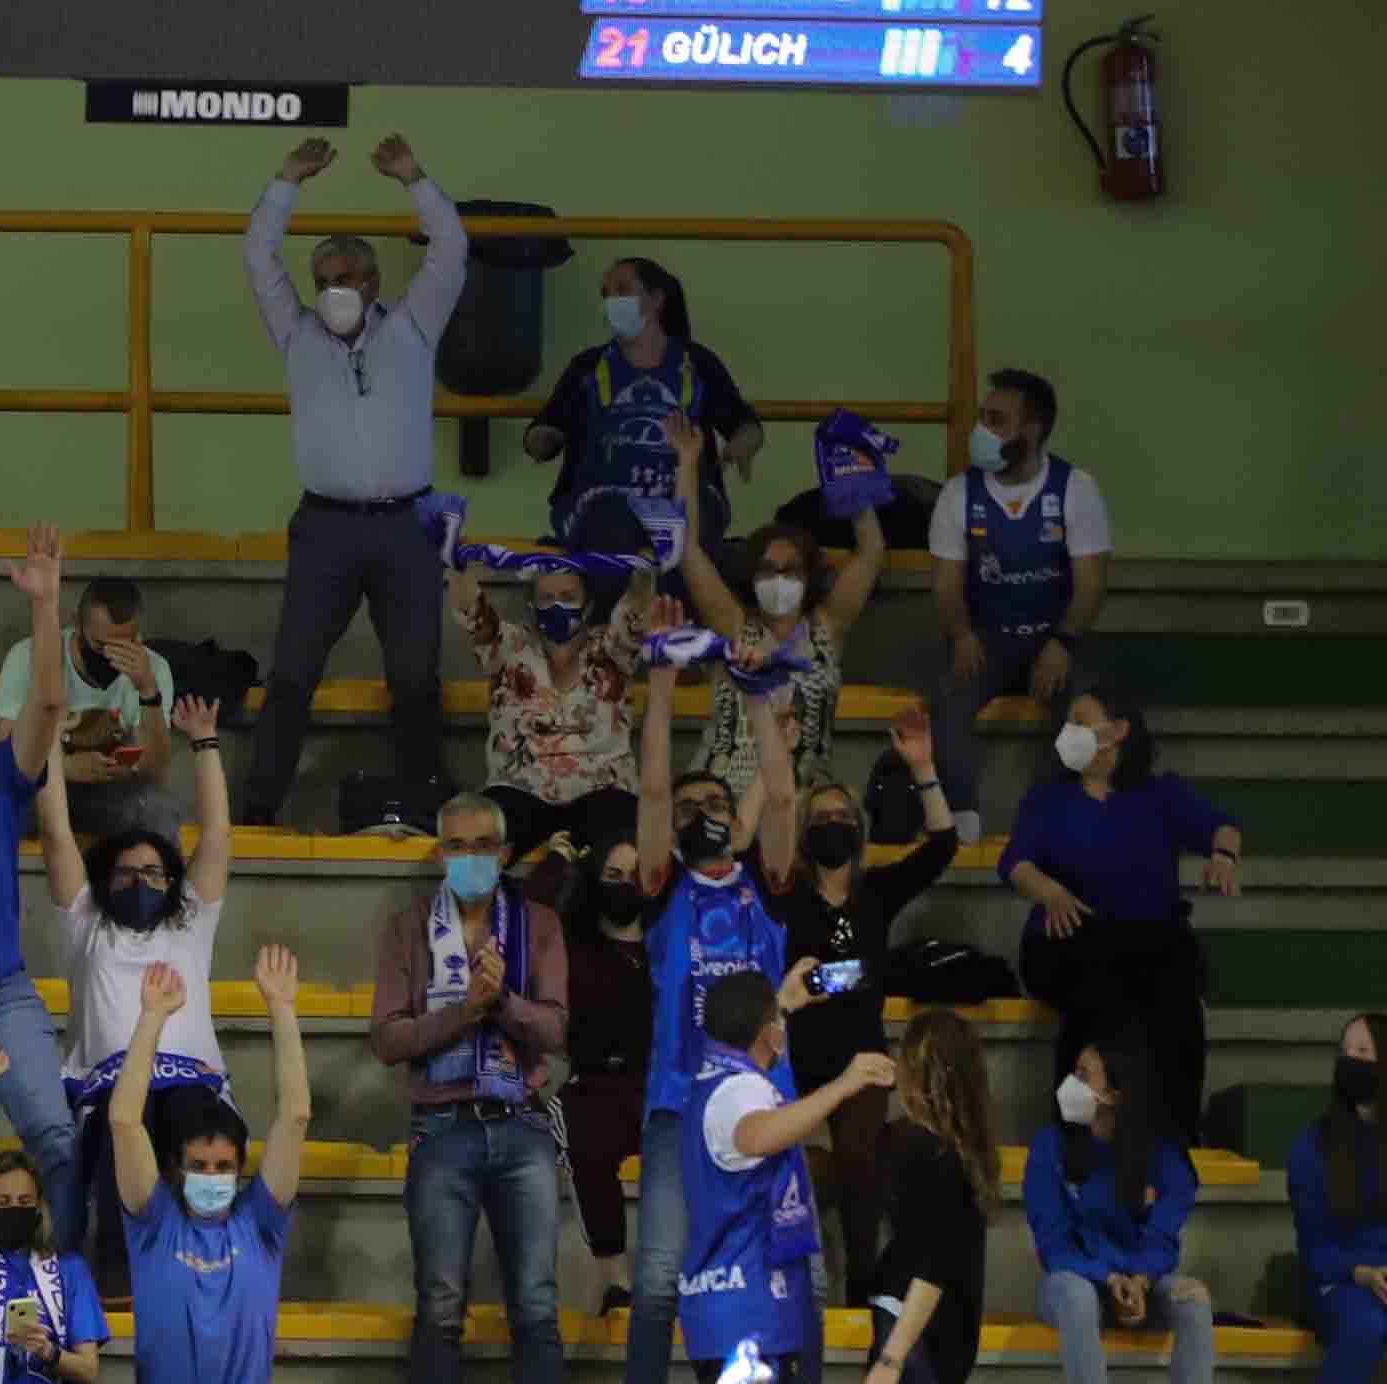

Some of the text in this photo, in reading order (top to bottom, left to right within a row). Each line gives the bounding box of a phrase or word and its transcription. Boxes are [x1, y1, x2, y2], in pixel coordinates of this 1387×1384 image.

[595, 25, 1034, 75] 21 GÜLICH 4
[160, 90, 303, 121] MONDO
